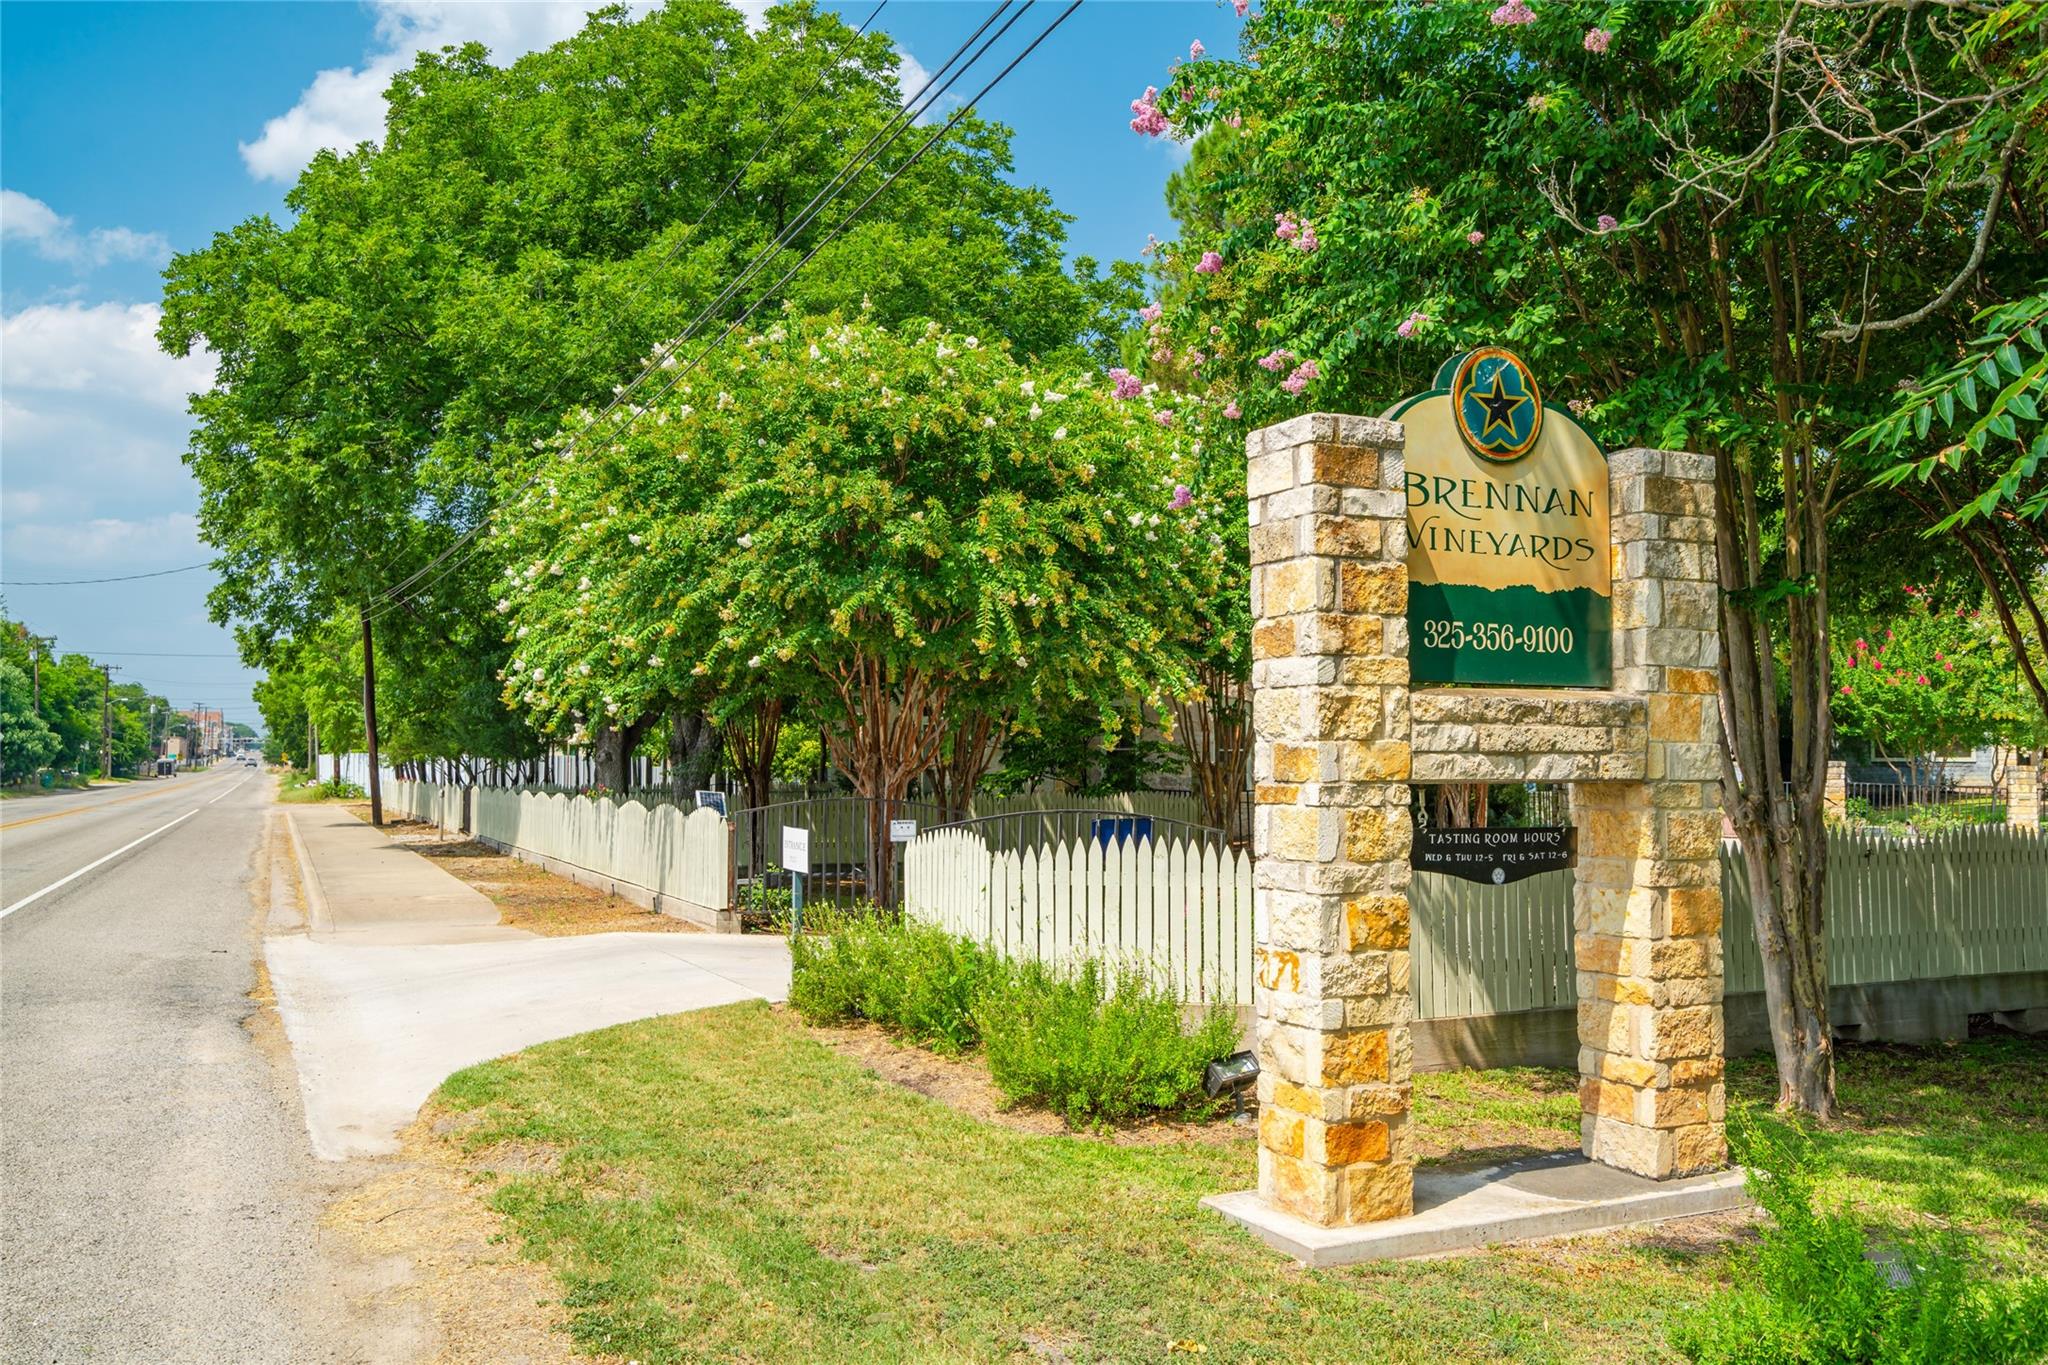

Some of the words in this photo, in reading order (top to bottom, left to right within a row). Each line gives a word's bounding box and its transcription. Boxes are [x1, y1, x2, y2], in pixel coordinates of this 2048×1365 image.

[1404, 471, 1594, 521] BRENNAN
[1406, 515, 1595, 571] VINEYARDS
[1423, 619, 1574, 654] 325-356-9100
[1429, 833, 1480, 845] TASTING
[1484, 833, 1518, 847] ROOM
[1524, 832, 1561, 846] HOURS
[1425, 853, 1443, 862] WED
[1455, 853, 1472, 862] THU
[1475, 853, 1494, 862] 12-5
[1502, 853, 1517, 864] FRI
[1519, 853, 1525, 861] &
[1528, 852, 1546, 860] SAT
[1548, 851, 1568, 859] 12-6
